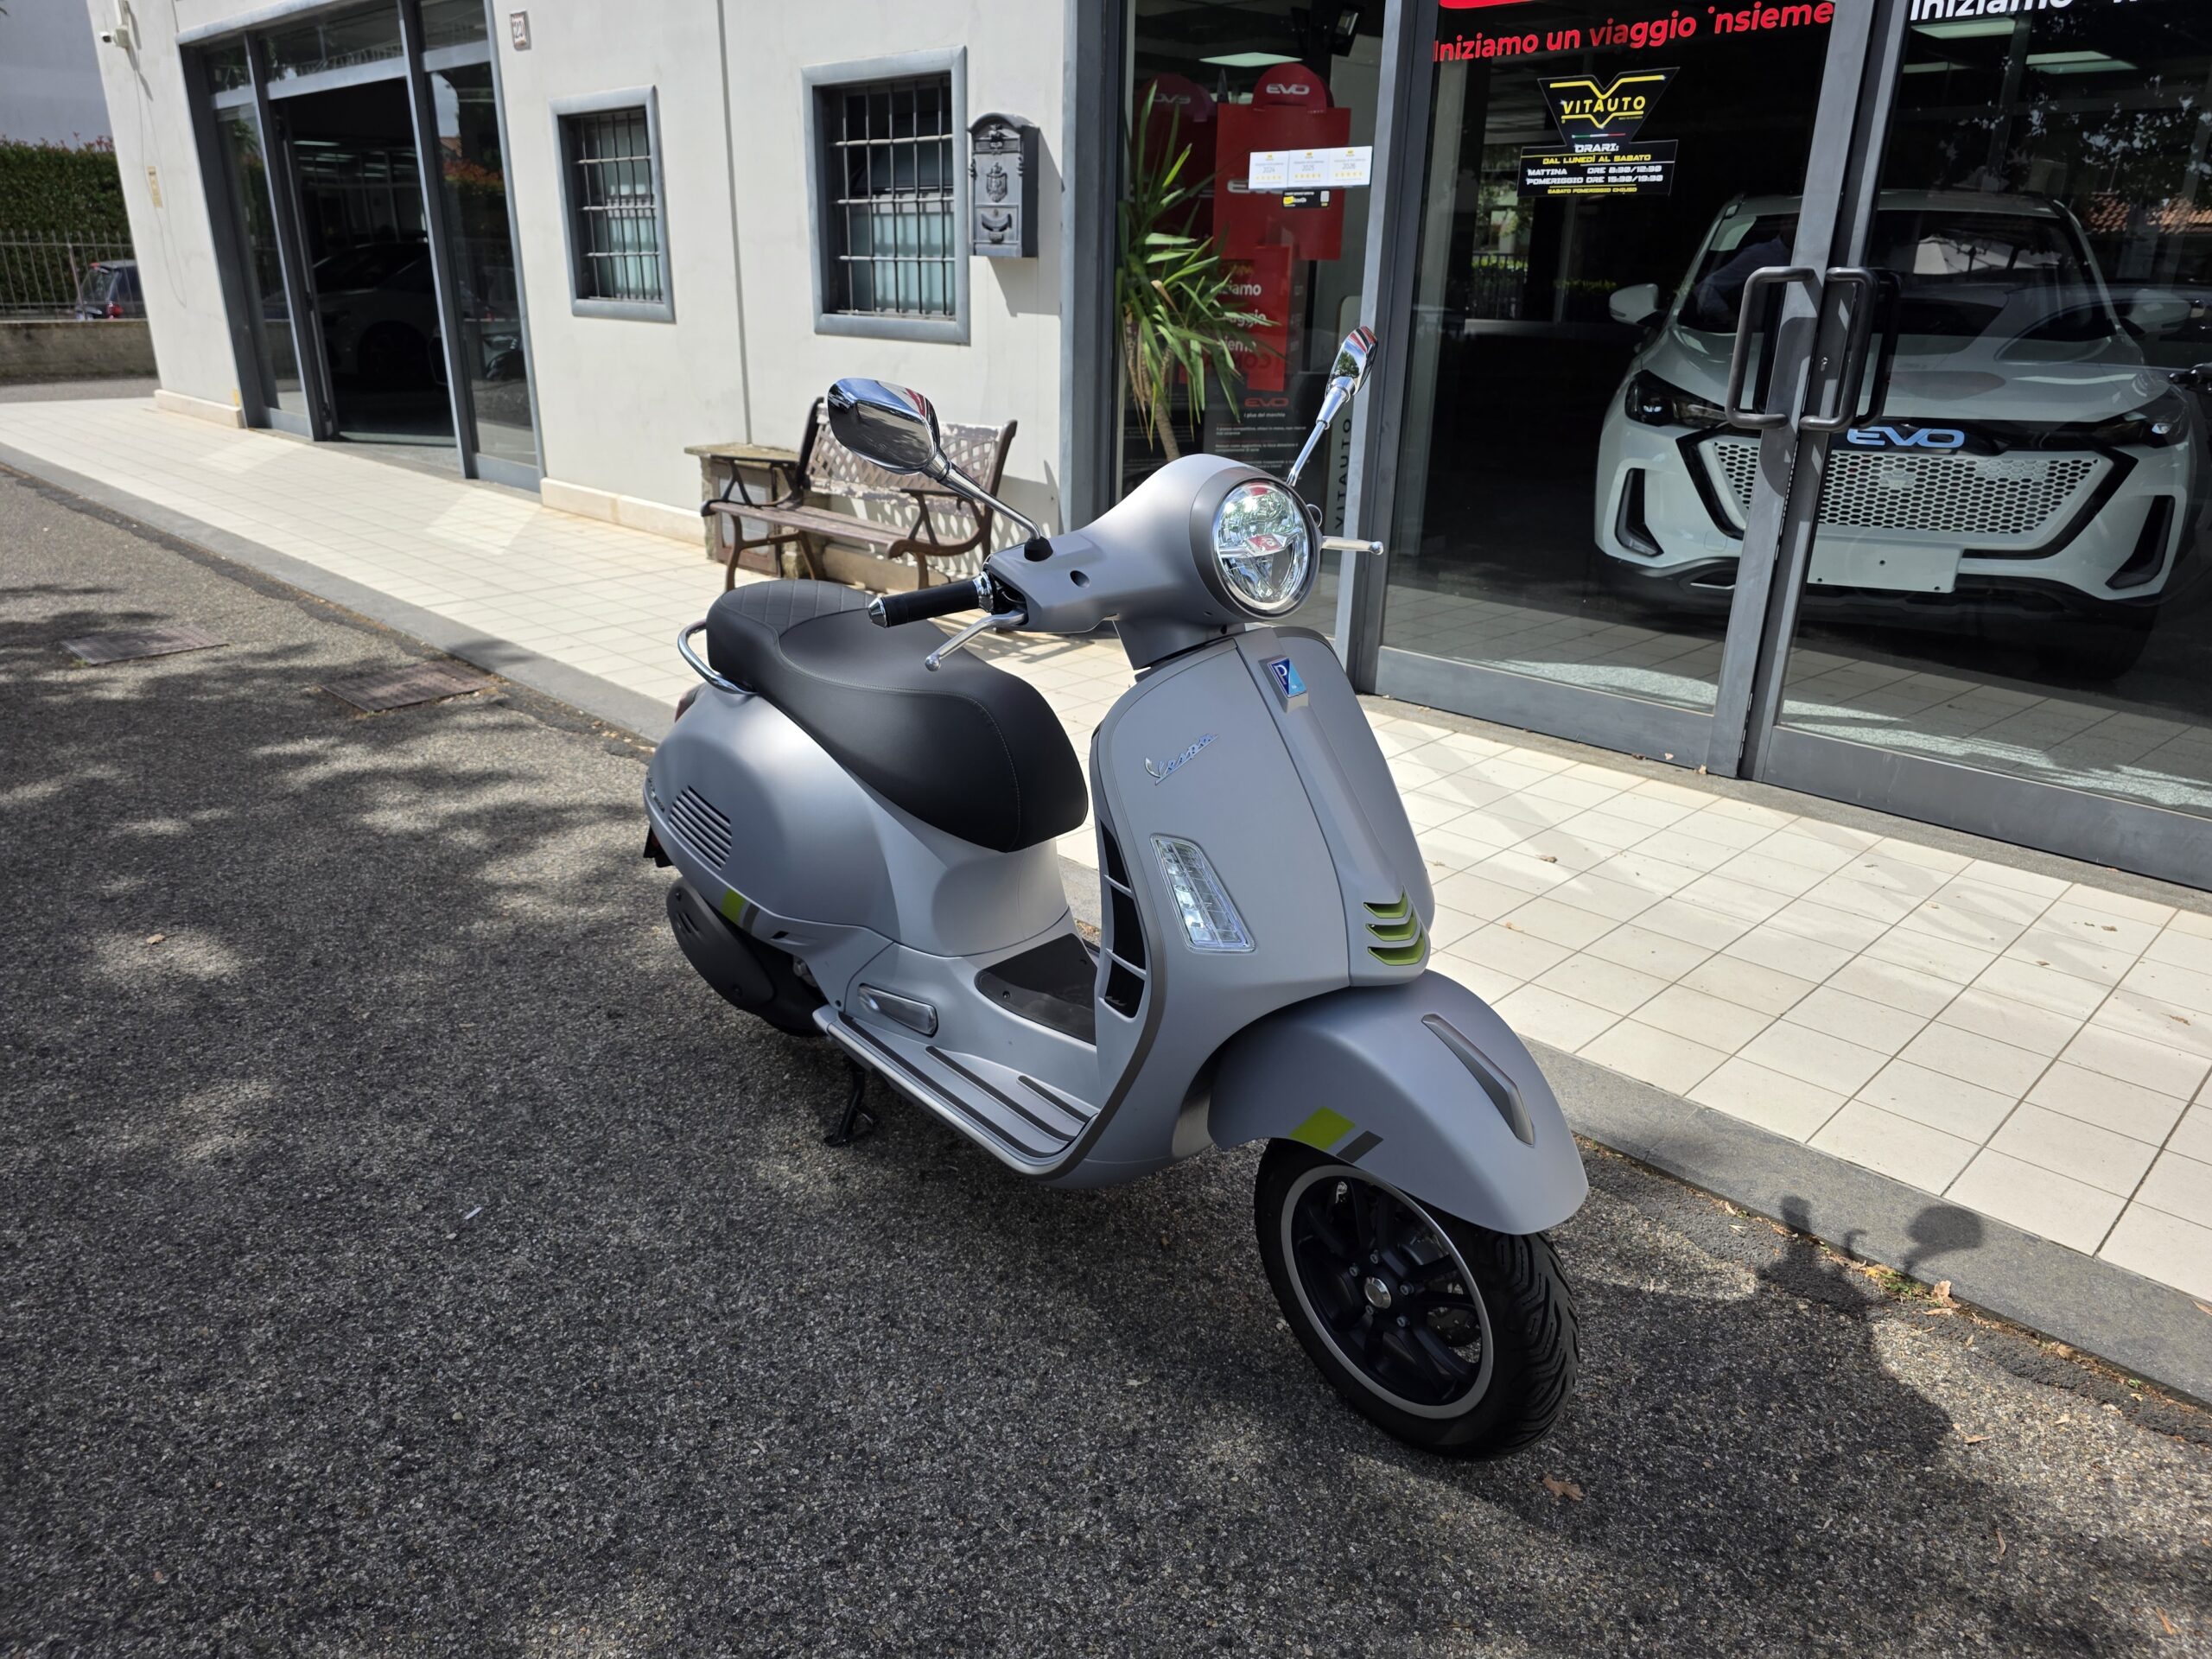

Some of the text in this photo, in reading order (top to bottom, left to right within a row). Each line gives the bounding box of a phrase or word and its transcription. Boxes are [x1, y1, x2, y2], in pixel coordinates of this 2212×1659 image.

[1433, 32, 1539, 62] Iniziamo
[1547, 29, 1580, 51] un
[1590, 10, 1697, 48] viaggio
[1266, 83, 1311, 95] EVO
[1562, 96, 1646, 114] VITAUTO
[1563, 155, 1596, 164] LUNEDÌ
[1614, 154, 1651, 162] SABATO
[1527, 168, 1567, 176] MATTINA
[1587, 166, 1606, 175] ORE
[1526, 176, 1584, 185] POMERIGGIO
[1586, 175, 1605, 184] ORE
[1244, 397, 1289, 407] EVO
[1847, 426, 1965, 448] EVO
[1335, 418, 1351, 530] VITAUTO
[1144, 733, 1219, 786] Vespa
